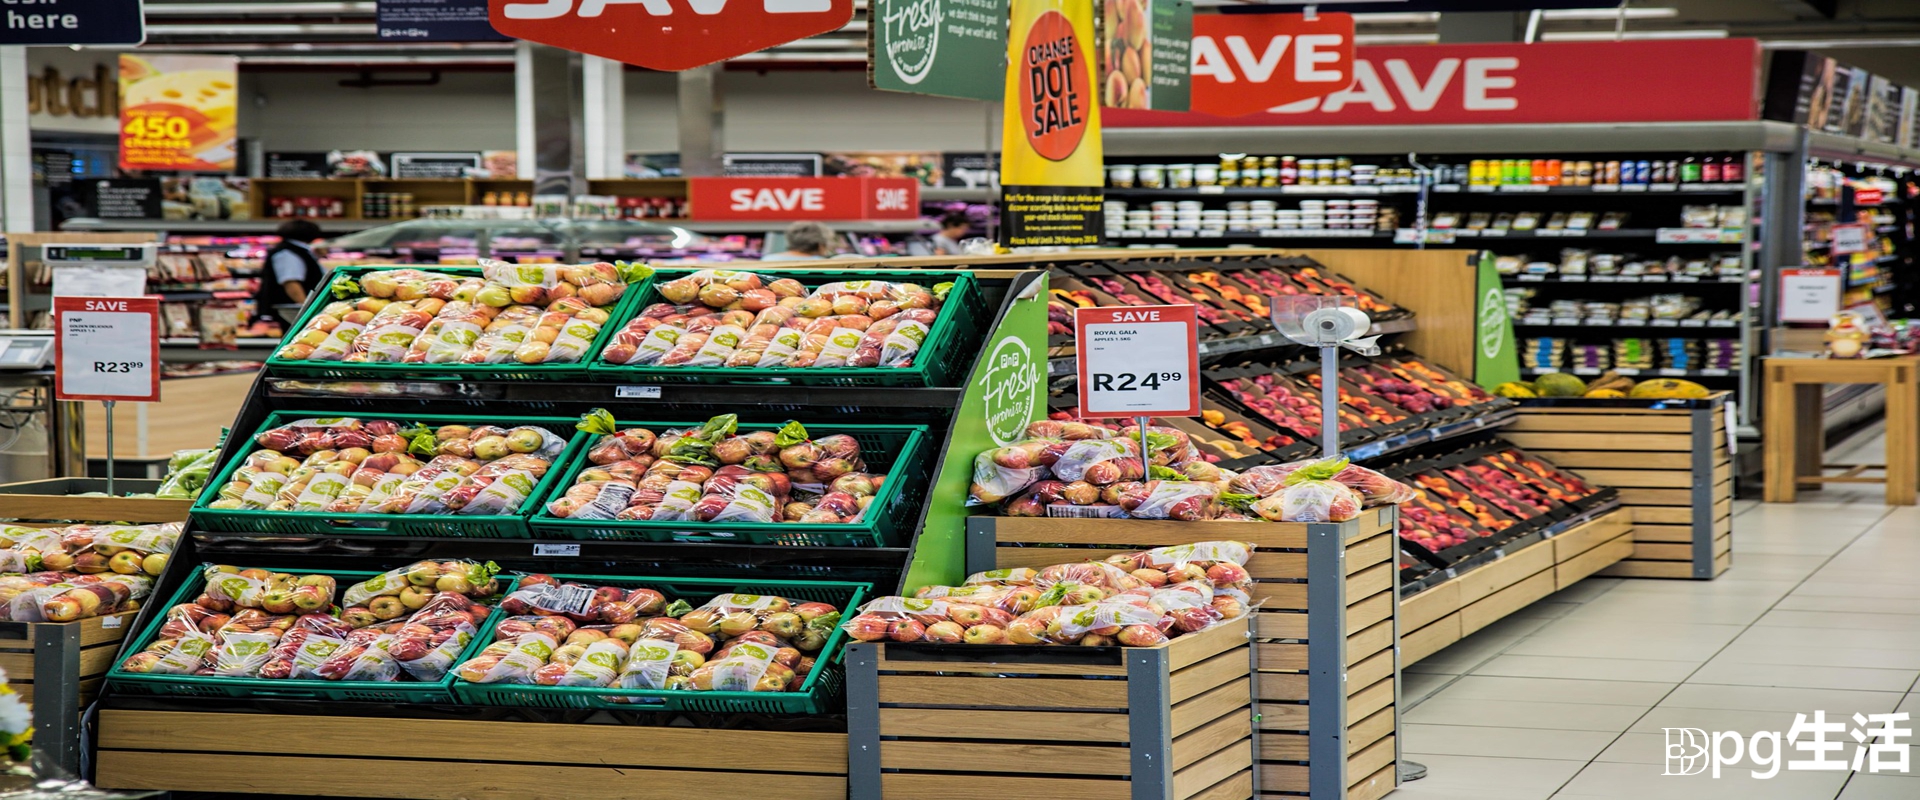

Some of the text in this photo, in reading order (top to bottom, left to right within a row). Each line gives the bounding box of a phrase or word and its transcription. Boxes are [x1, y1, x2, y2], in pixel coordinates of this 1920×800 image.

[7, 10, 79, 29] here
[1029, 36, 1073, 66] ORANGE
[1030, 57, 1073, 103] DOT
[1266, 57, 1520, 113] AVE
[1033, 94, 1081, 137] SALE
[124, 117, 190, 139] 450
[730, 188, 825, 211] SAVE
[876, 188, 909, 210] SAVE
[86, 301, 128, 311] SAVE
[1112, 311, 1160, 322] SAVE
[979, 347, 1041, 408] Fresh
[991, 401, 1023, 437] promise
[1002, 430, 1012, 439] your
